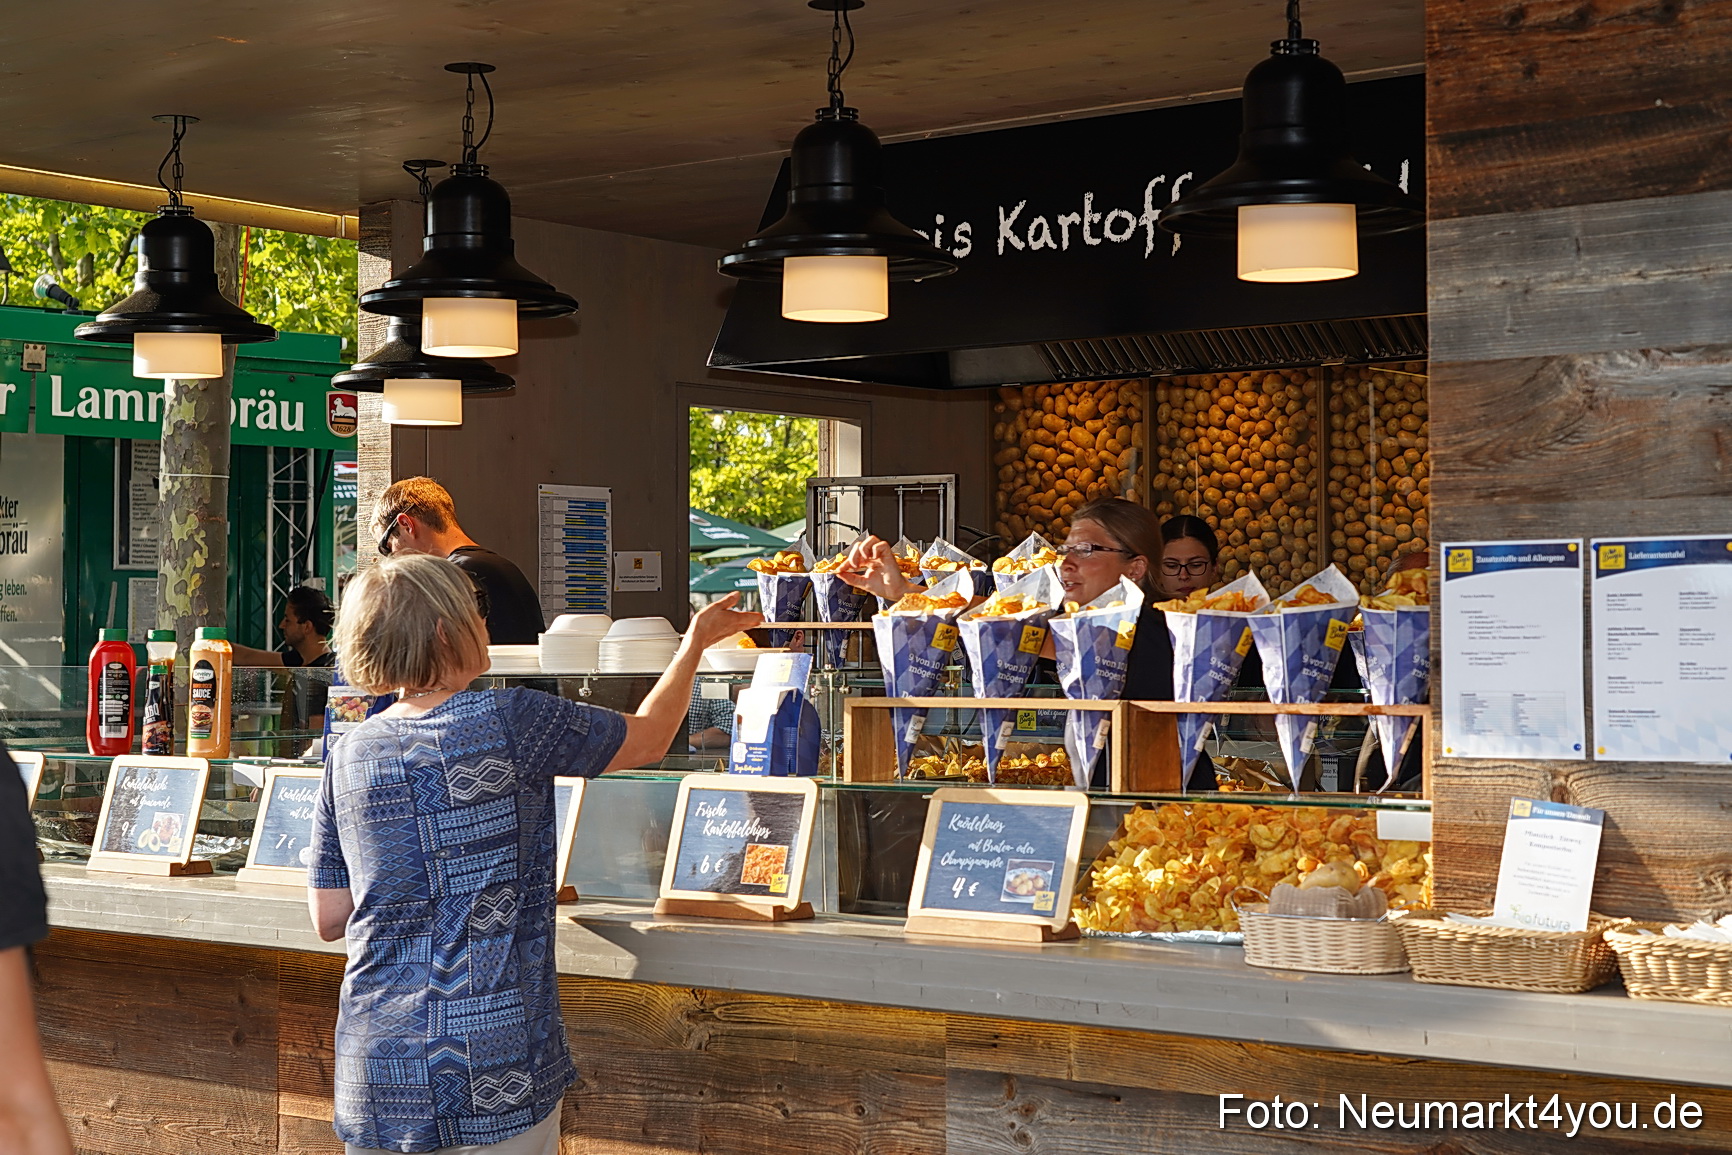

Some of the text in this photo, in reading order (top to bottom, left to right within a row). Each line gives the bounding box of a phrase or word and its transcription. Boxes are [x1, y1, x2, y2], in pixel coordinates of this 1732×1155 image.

[336, 424, 352, 433] 1628
[908, 652, 915, 661] 9
[915, 656, 931, 667] von
[931, 661, 941, 670] 10
[997, 659, 1003, 668] 9
[1004, 662, 1019, 672] von
[1094, 655, 1101, 664] 9
[1102, 658, 1117, 668] von
[1210, 656, 1217, 666] 9
[1302, 654, 1309, 663] 9
[1413, 654, 1420, 663] 9
[908, 665, 936, 679] mögen
[997, 672, 1024, 684] mögen
[192, 688, 212, 699] SAUCE
[694, 797, 728, 818] Frische
[121, 821, 130, 838] 9
[702, 816, 771, 842] Kartoffelchips
[948, 813, 1006, 833] Knödelinos
[275, 833, 287, 850] 7
[968, 838, 984, 853] mit
[1015, 841, 1036, 855] oder
[700, 854, 724, 874] 6 €
[951, 876, 980, 899] 4 €
